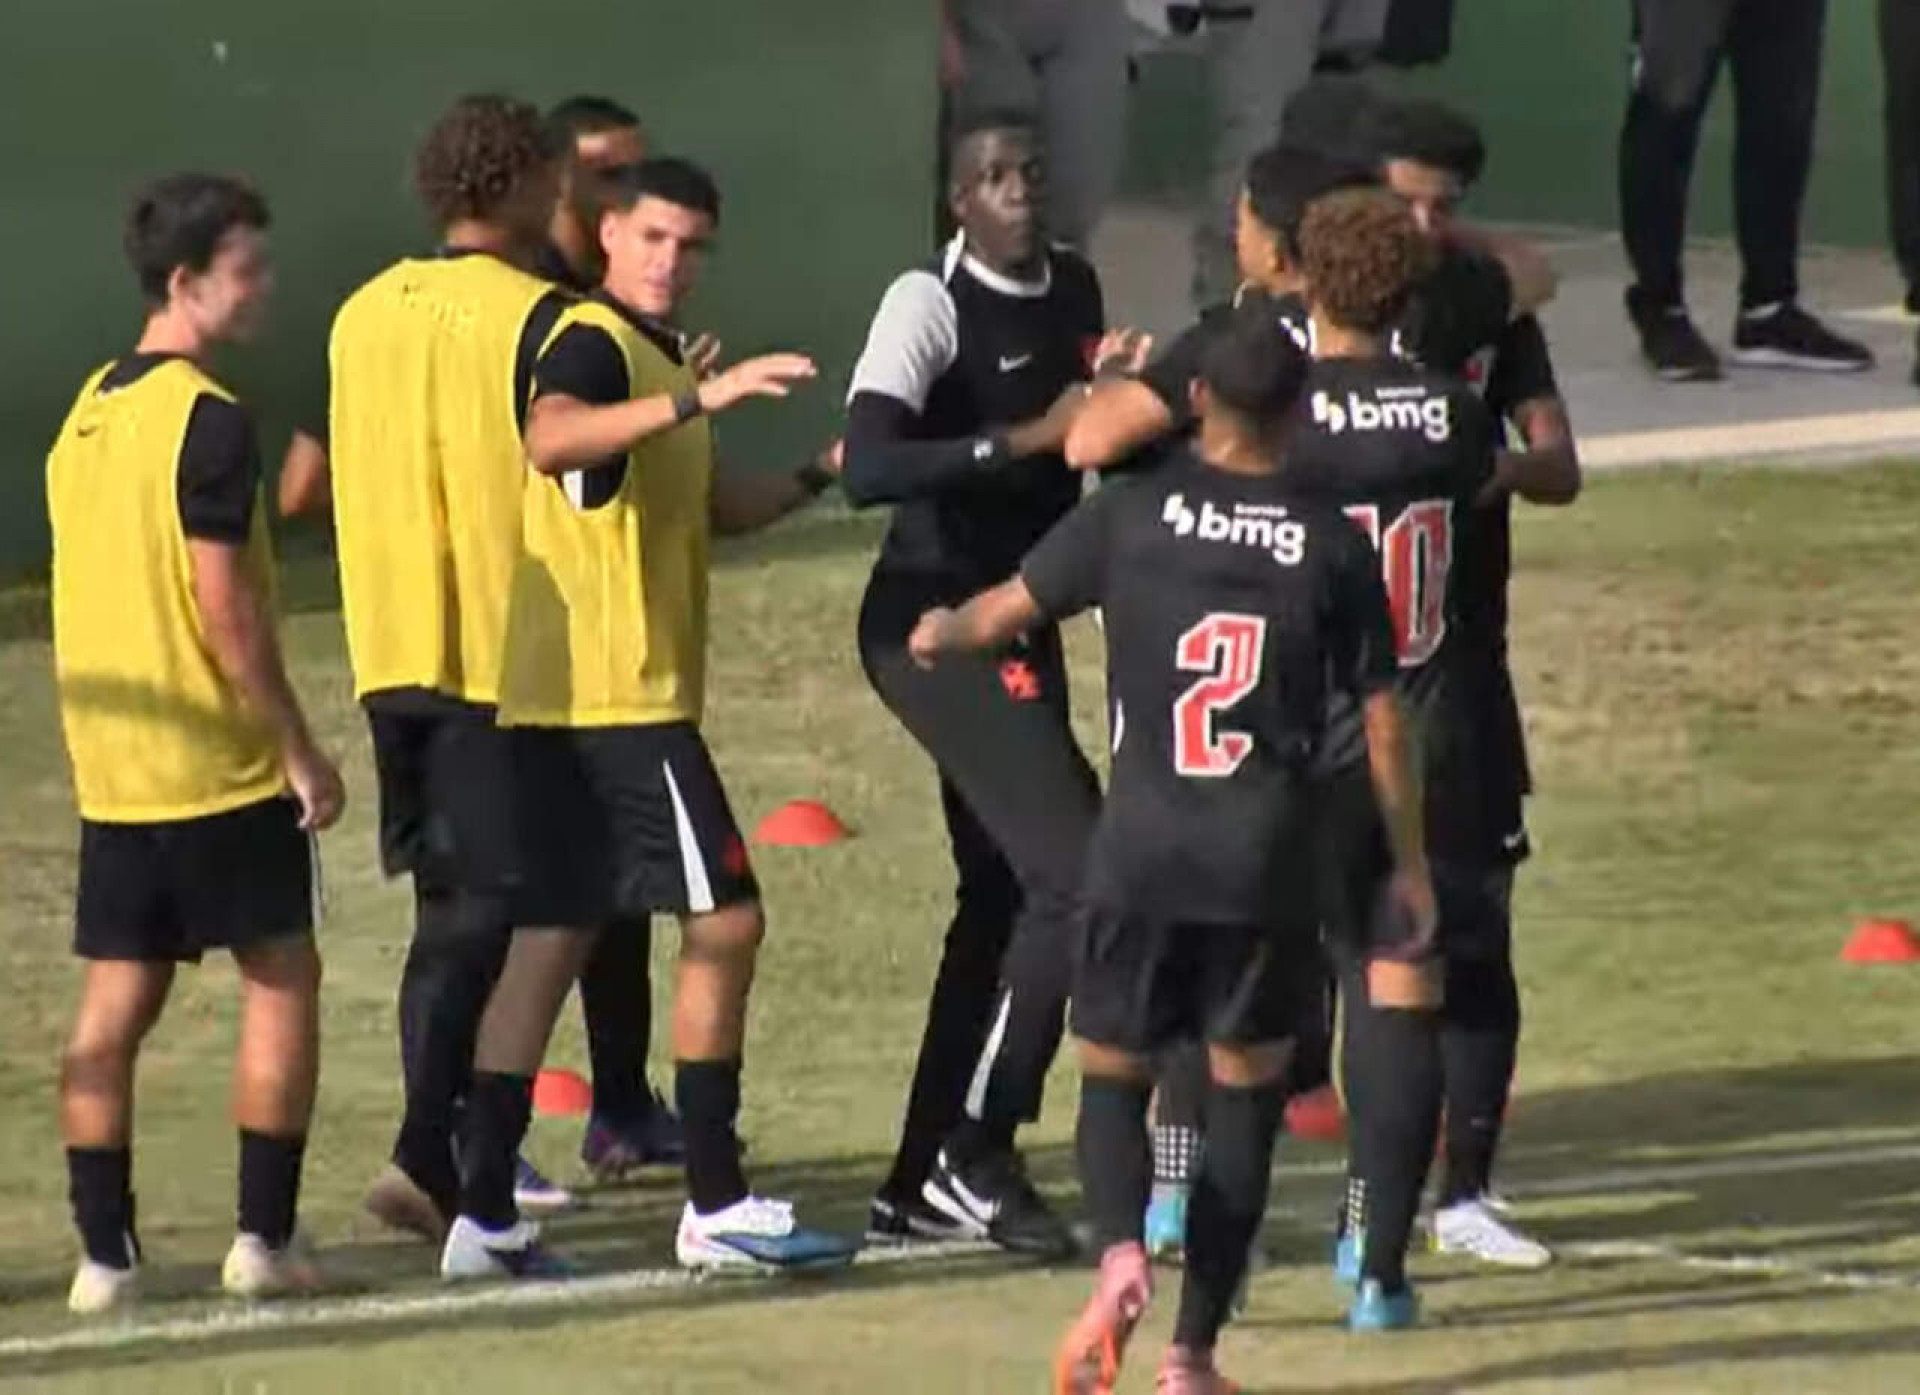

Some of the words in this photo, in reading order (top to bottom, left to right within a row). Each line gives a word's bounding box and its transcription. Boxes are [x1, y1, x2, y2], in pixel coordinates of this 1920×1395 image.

[1347, 391, 1449, 442] bmg
[1197, 501, 1306, 566] bmg
[1341, 499, 1454, 668] 0
[1173, 612, 1266, 777] 2
